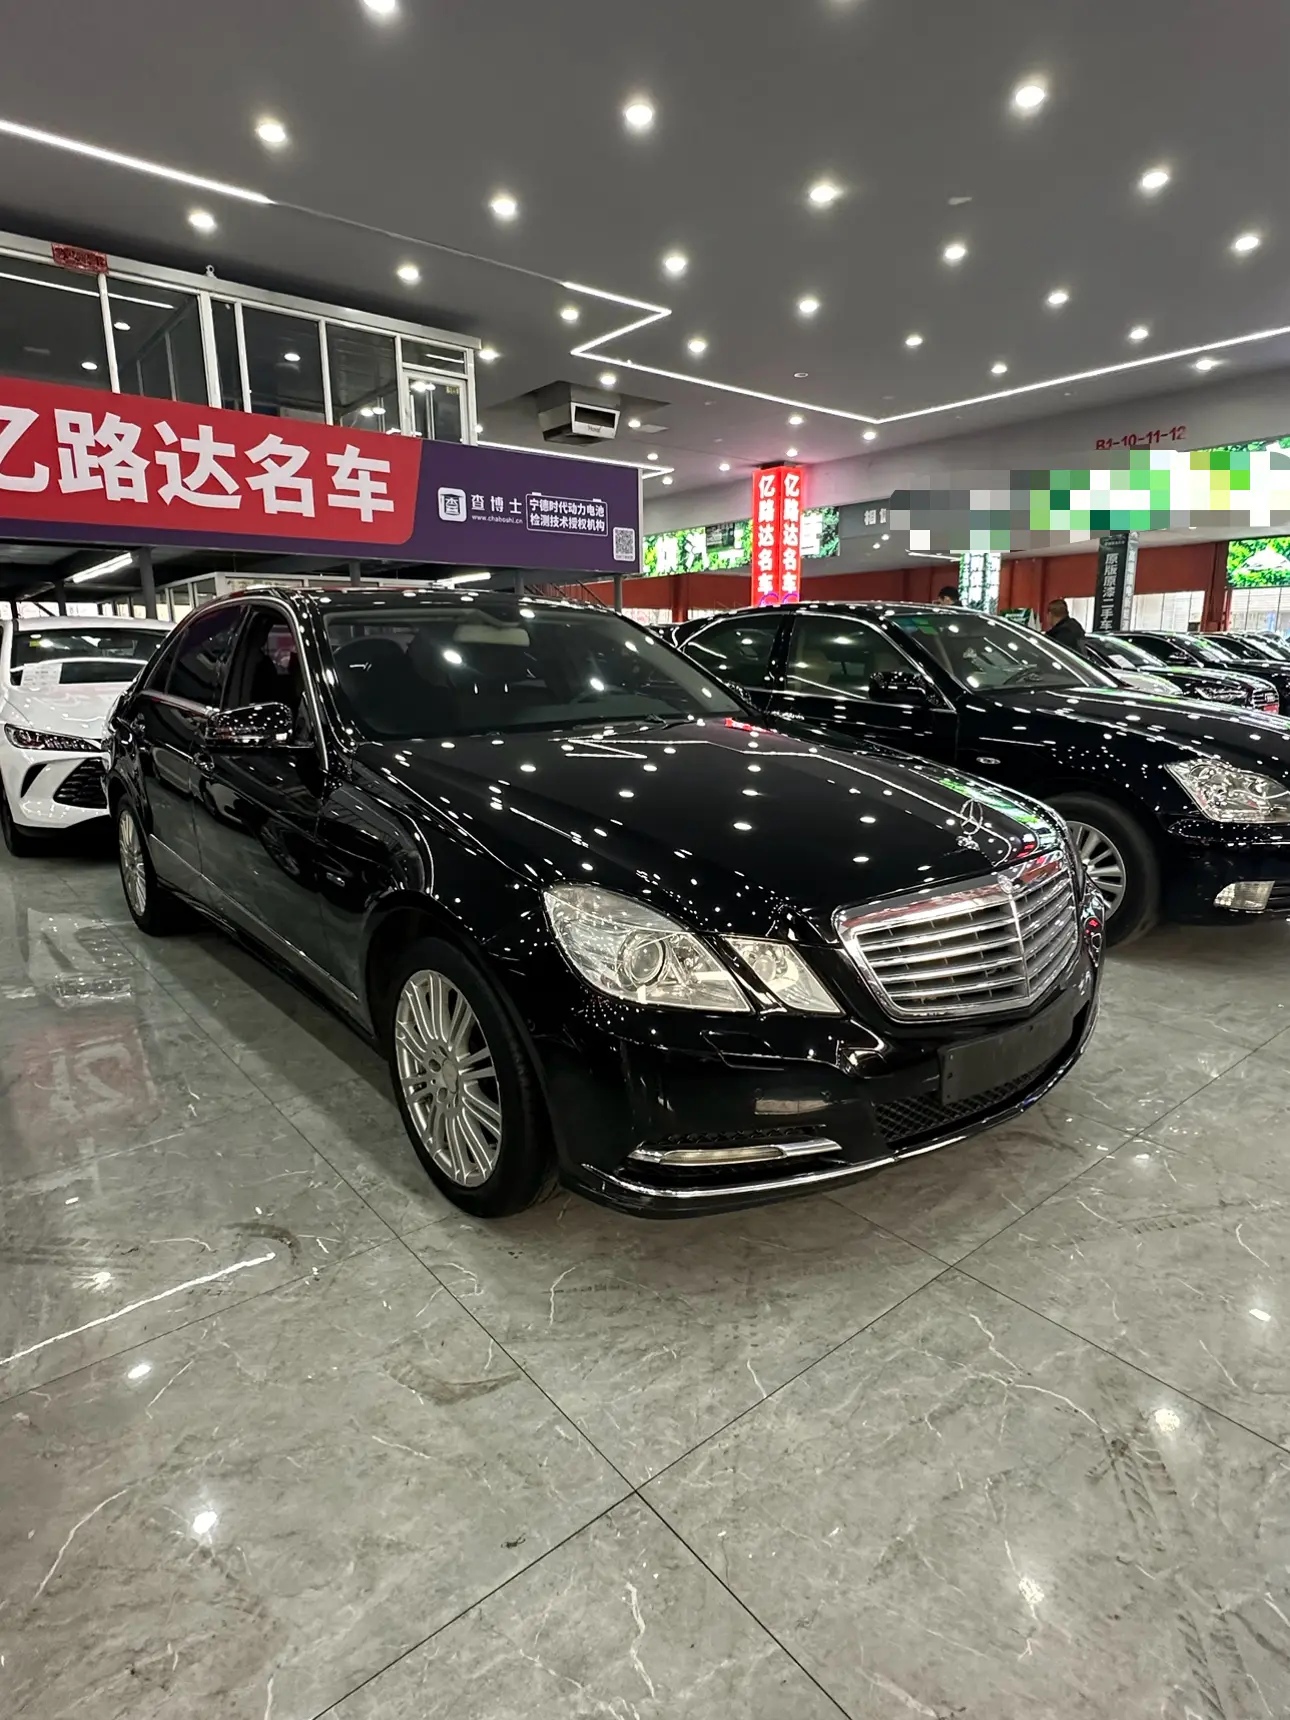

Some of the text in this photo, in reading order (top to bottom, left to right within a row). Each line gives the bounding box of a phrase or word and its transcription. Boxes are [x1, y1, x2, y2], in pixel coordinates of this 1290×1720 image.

[0, 405, 394, 522] 亿路达名车
[470, 494, 523, 515] 查博士
[471, 513, 523, 524] www.chaboshi.cn
[529, 498, 605, 518] 宁德时代动力电池
[529, 512, 605, 533] 检测技术授权机构
[758, 474, 776, 595] 亿路达名车
[782, 472, 800, 595] 亿路达名车
[1100, 552, 1119, 630] 原版原漆二手车
